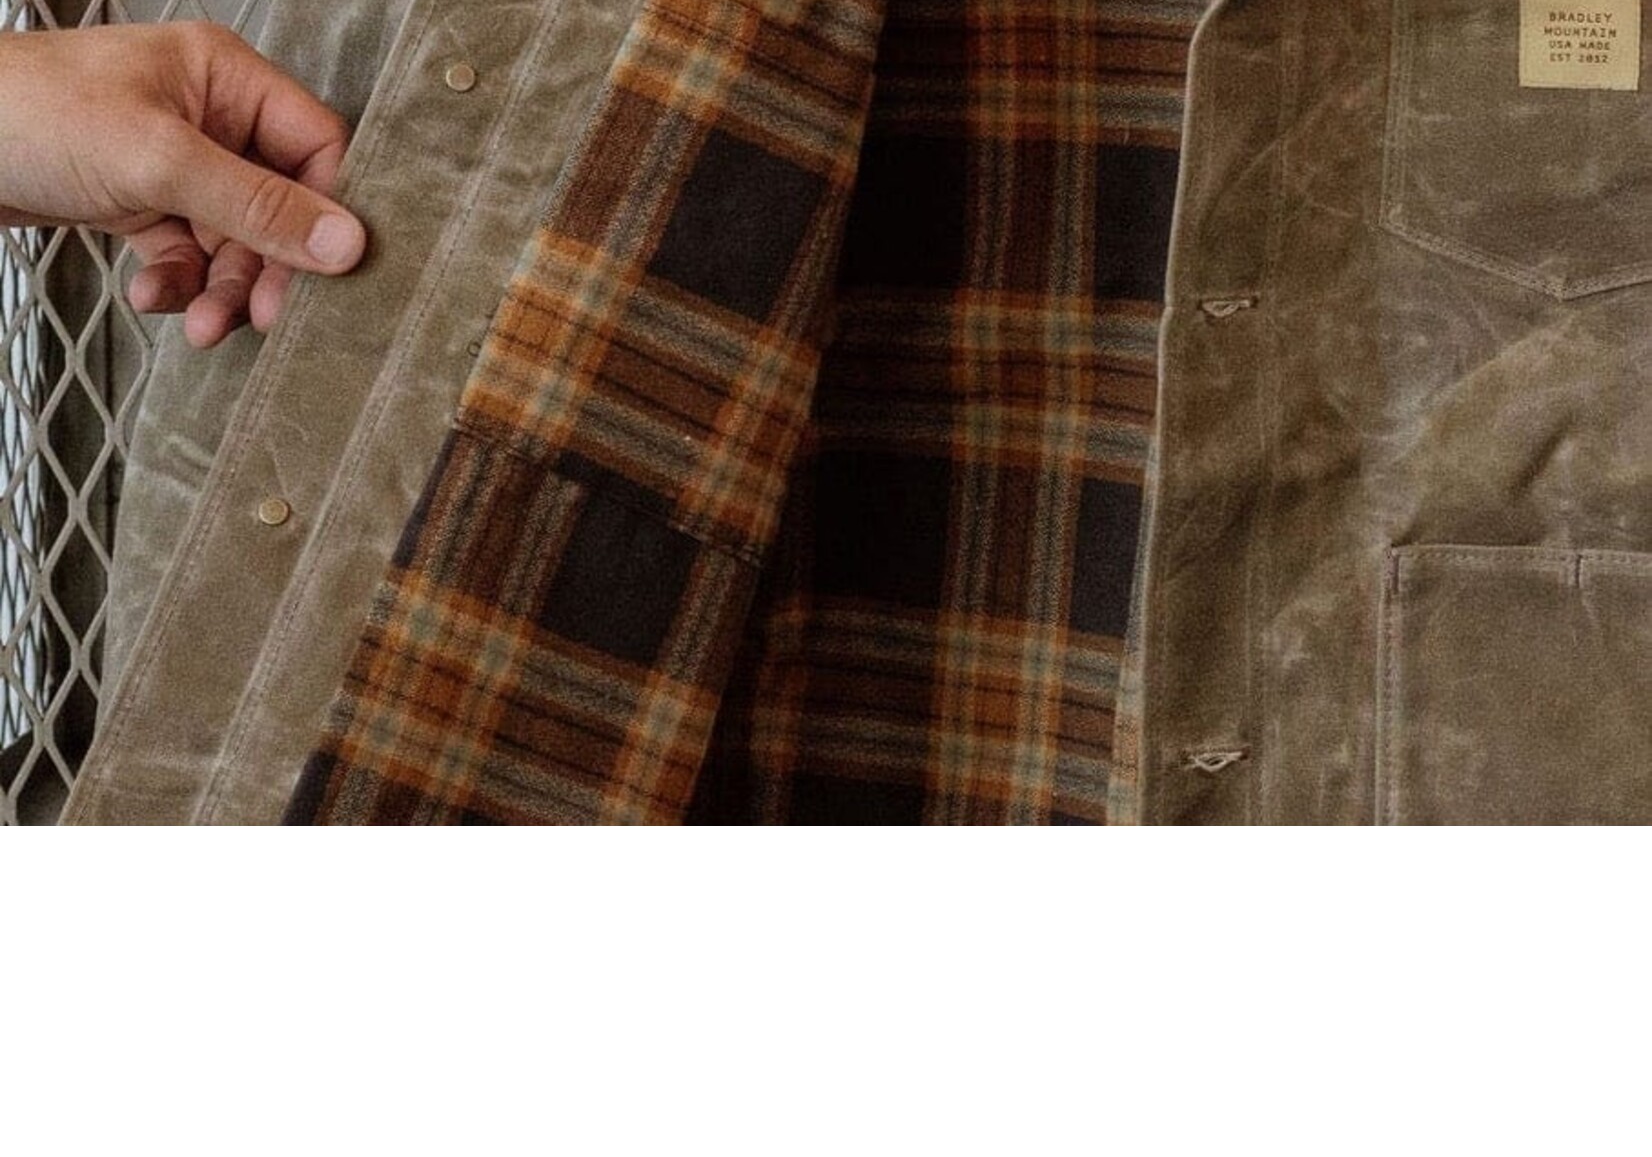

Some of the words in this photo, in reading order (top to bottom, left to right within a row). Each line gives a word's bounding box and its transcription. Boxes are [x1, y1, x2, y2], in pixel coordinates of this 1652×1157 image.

[1549, 12, 1612, 23] BRADLEY
[1544, 27, 1617, 38] MOUNTAIN
[1549, 41, 1571, 49] USA
[1579, 41, 1611, 50] MADE
[1550, 53, 1571, 62] EST
